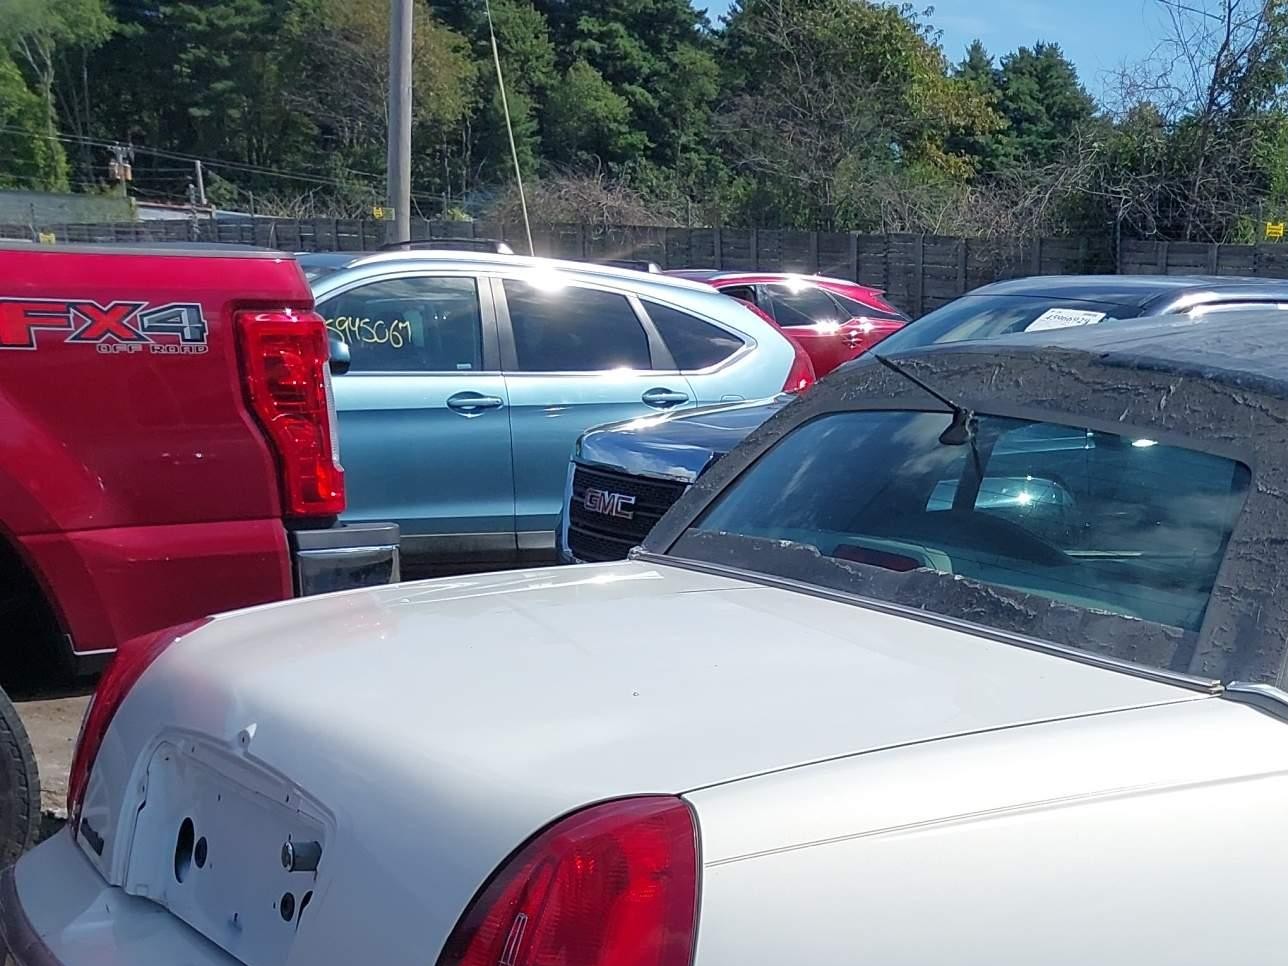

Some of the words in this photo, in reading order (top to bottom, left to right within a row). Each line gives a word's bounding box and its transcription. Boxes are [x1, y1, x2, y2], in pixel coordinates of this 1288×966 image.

[0, 297, 208, 350] FX4
[96, 343, 143, 354] OFF
[150, 344, 209, 354] ROAD
[584, 488, 636, 519] GMC
